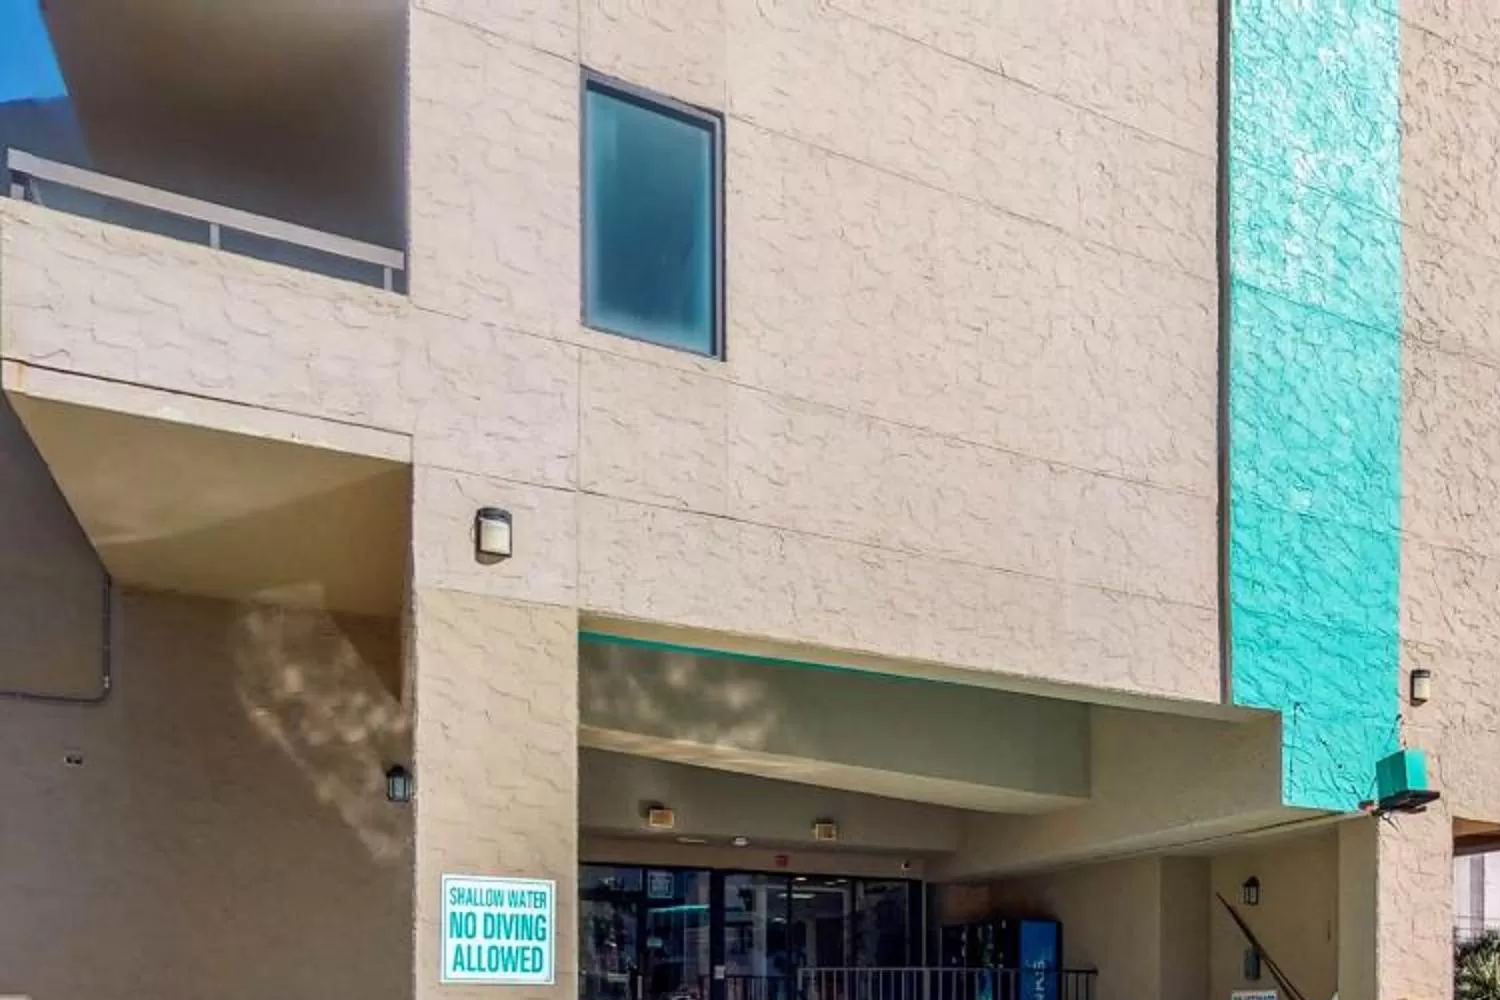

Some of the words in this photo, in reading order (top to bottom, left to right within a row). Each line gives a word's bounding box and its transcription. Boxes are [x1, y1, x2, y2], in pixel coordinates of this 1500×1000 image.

[449, 887, 504, 907] SHALLOW
[508, 889, 547, 909] WATER
[449, 911, 477, 939] NO
[483, 912, 546, 941] DIVING
[452, 943, 543, 973] ALLOWED
